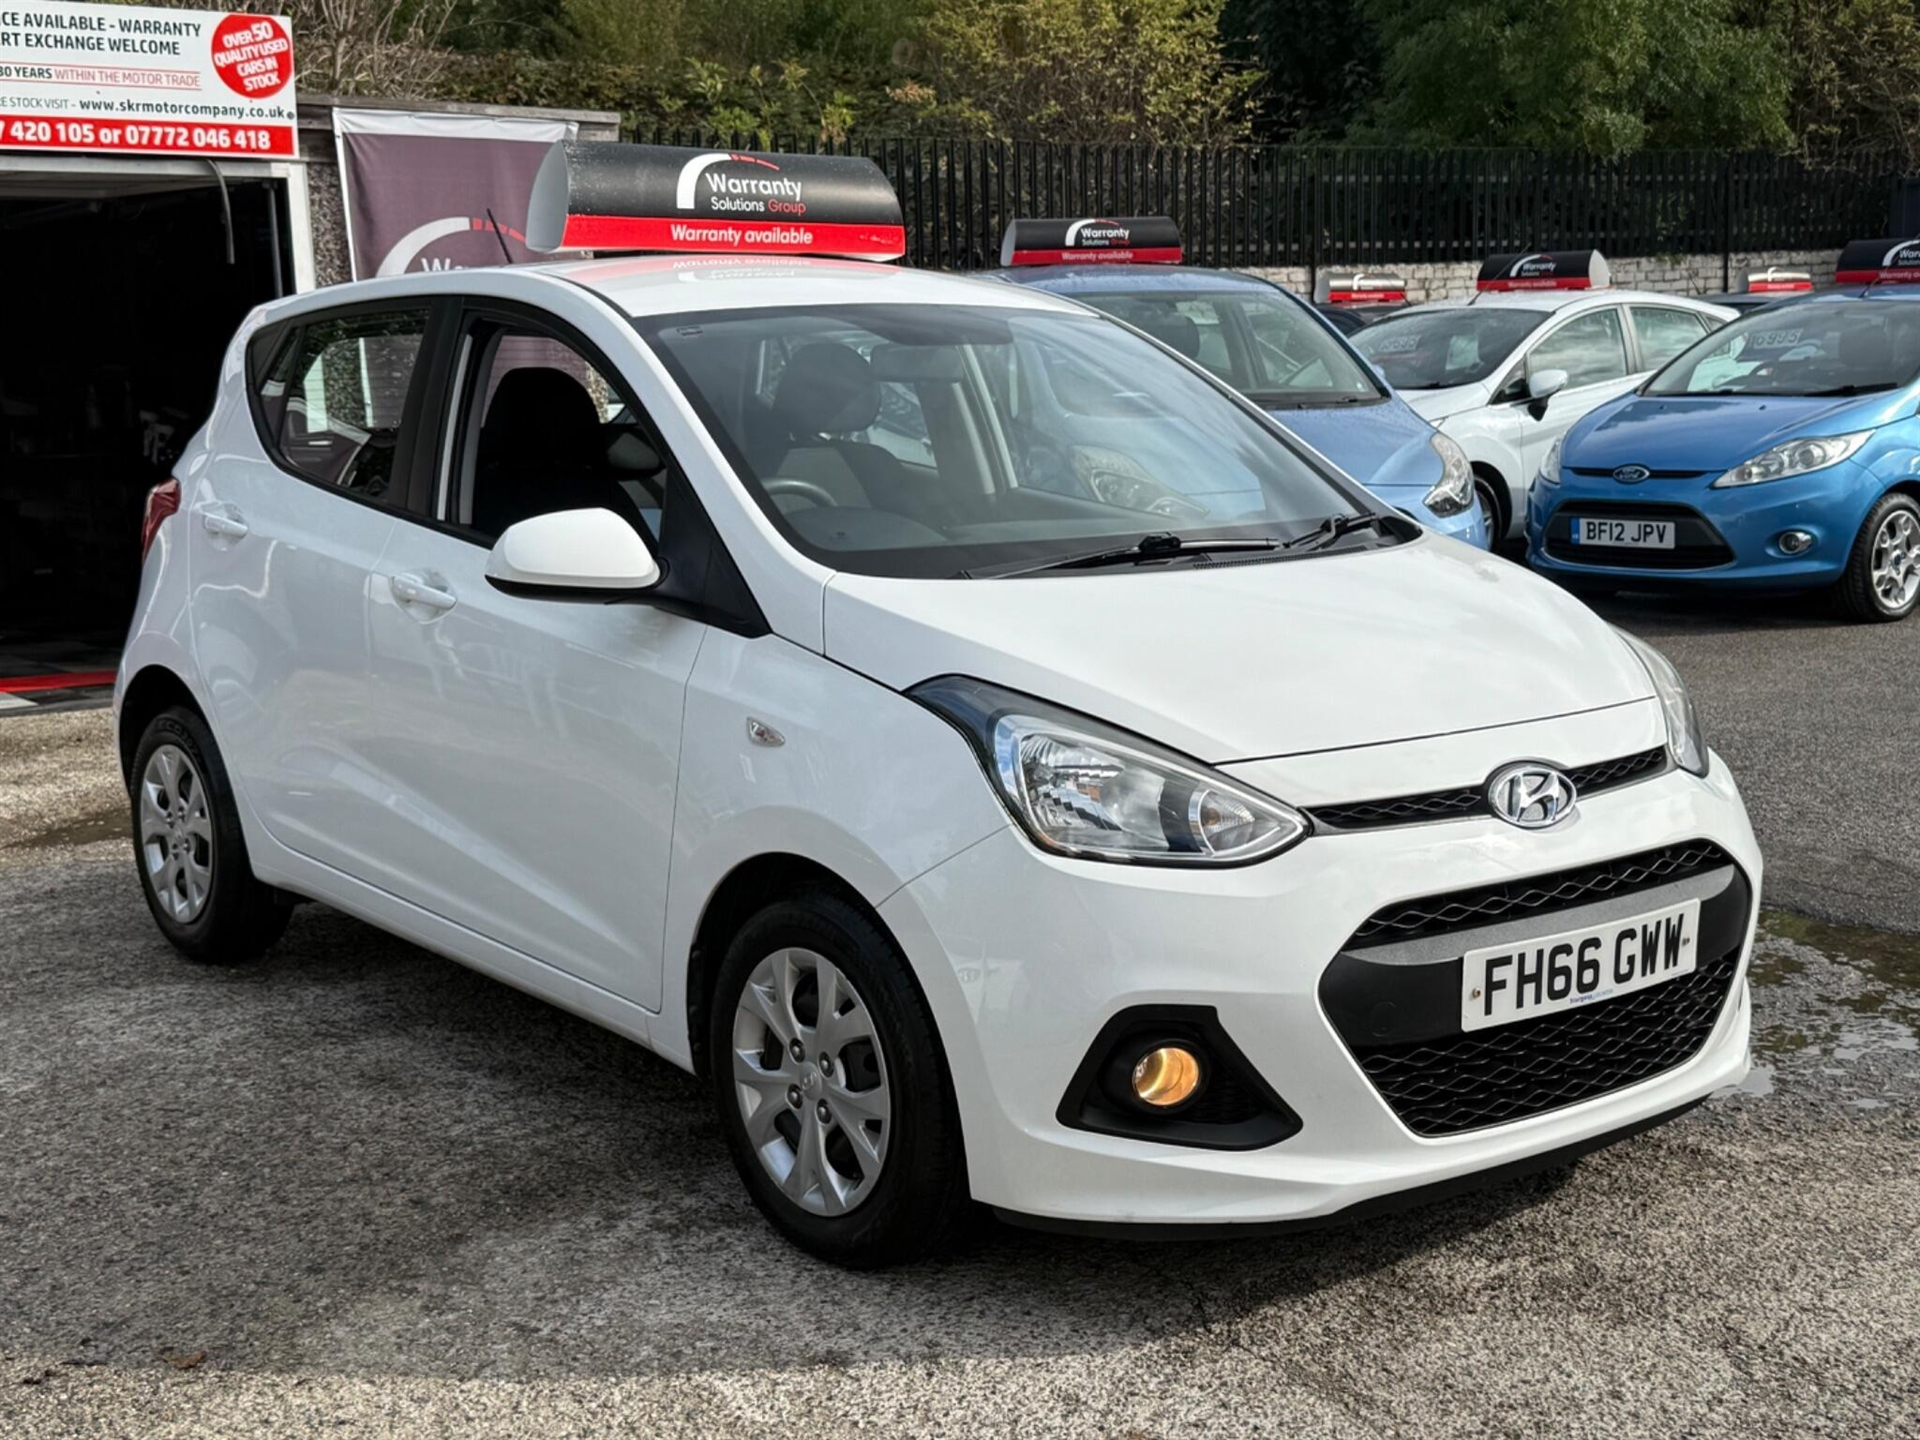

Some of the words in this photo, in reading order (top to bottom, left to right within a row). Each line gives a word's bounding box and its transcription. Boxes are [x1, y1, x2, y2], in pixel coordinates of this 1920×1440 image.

[0, 12, 20, 27] CE
[24, 13, 107, 31] AVAILABLE
[118, 18, 201, 38] WARRANTY
[222, 30, 254, 49] OVER
[250, 21, 274, 42] 50
[0, 32, 21, 46] RT
[25, 33, 105, 51] EXCHANGE
[108, 37, 181, 56] WELCOME
[214, 44, 260, 68] QUALITY
[259, 38, 289, 56] USED
[14, 66, 53, 80] YEARS
[54, 68, 95, 81] WITHIN
[98, 70, 120, 84] THE
[122, 72, 164, 86] MOTOR
[166, 74, 201, 88] TRADE
[236, 58, 266, 77] CARS
[264, 55, 279, 71] IN
[243, 71, 281, 92] STOCK
[9, 97, 43, 109] STOCK
[44, 98, 70, 110] VISIT
[79, 99, 285, 120] www.skrmotorcompany.co.uk
[10, 121, 52, 142] 420
[55, 122, 96, 144] 105
[99, 127, 121, 144] or
[125, 124, 190, 147] 07772
[193, 127, 231, 148] 046
[234, 130, 271, 150] 418
[705, 172, 802, 202] Warranty
[711, 196, 765, 212] Solutions
[768, 198, 807, 216] Group
[671, 224, 742, 247] Warranty
[744, 227, 813, 245] available
[1081, 228, 1130, 240] Warranty
[1062, 252, 1096, 262] Warranty
[1098, 251, 1133, 260] available
[1586, 521, 1626, 542] BF12
[1630, 523, 1667, 544] JPV
[1484, 936, 1602, 1017] FH66
[1613, 913, 1684, 984] GWW
